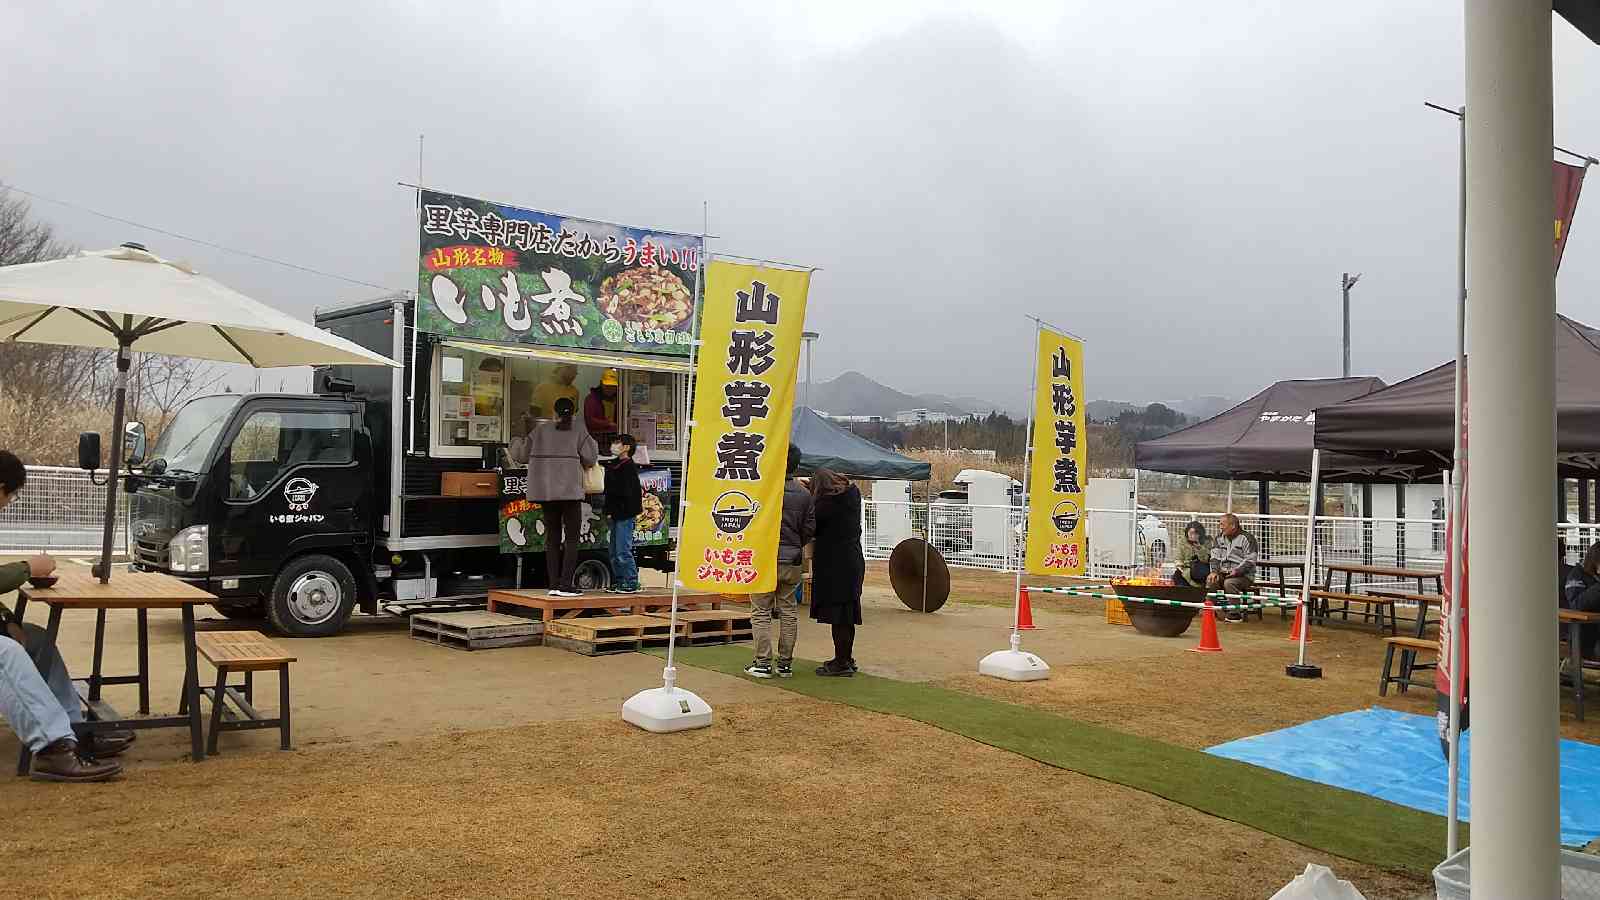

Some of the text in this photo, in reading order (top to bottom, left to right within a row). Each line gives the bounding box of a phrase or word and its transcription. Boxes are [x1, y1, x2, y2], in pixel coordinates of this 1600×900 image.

[431, 247, 505, 267] 山形名物
[431, 266, 586, 337] いも煮
[714, 280, 780, 481] 山形芋煮
[1051, 346, 1082, 494] 山形芋煮
[269, 514, 325, 524] いも煮ジャパン
[705, 548, 754, 566] いも煮
[1050, 543, 1079, 556] いも煮
[1044, 556, 1080, 569] ジャパン
[697, 565, 758, 584] ジャパン
